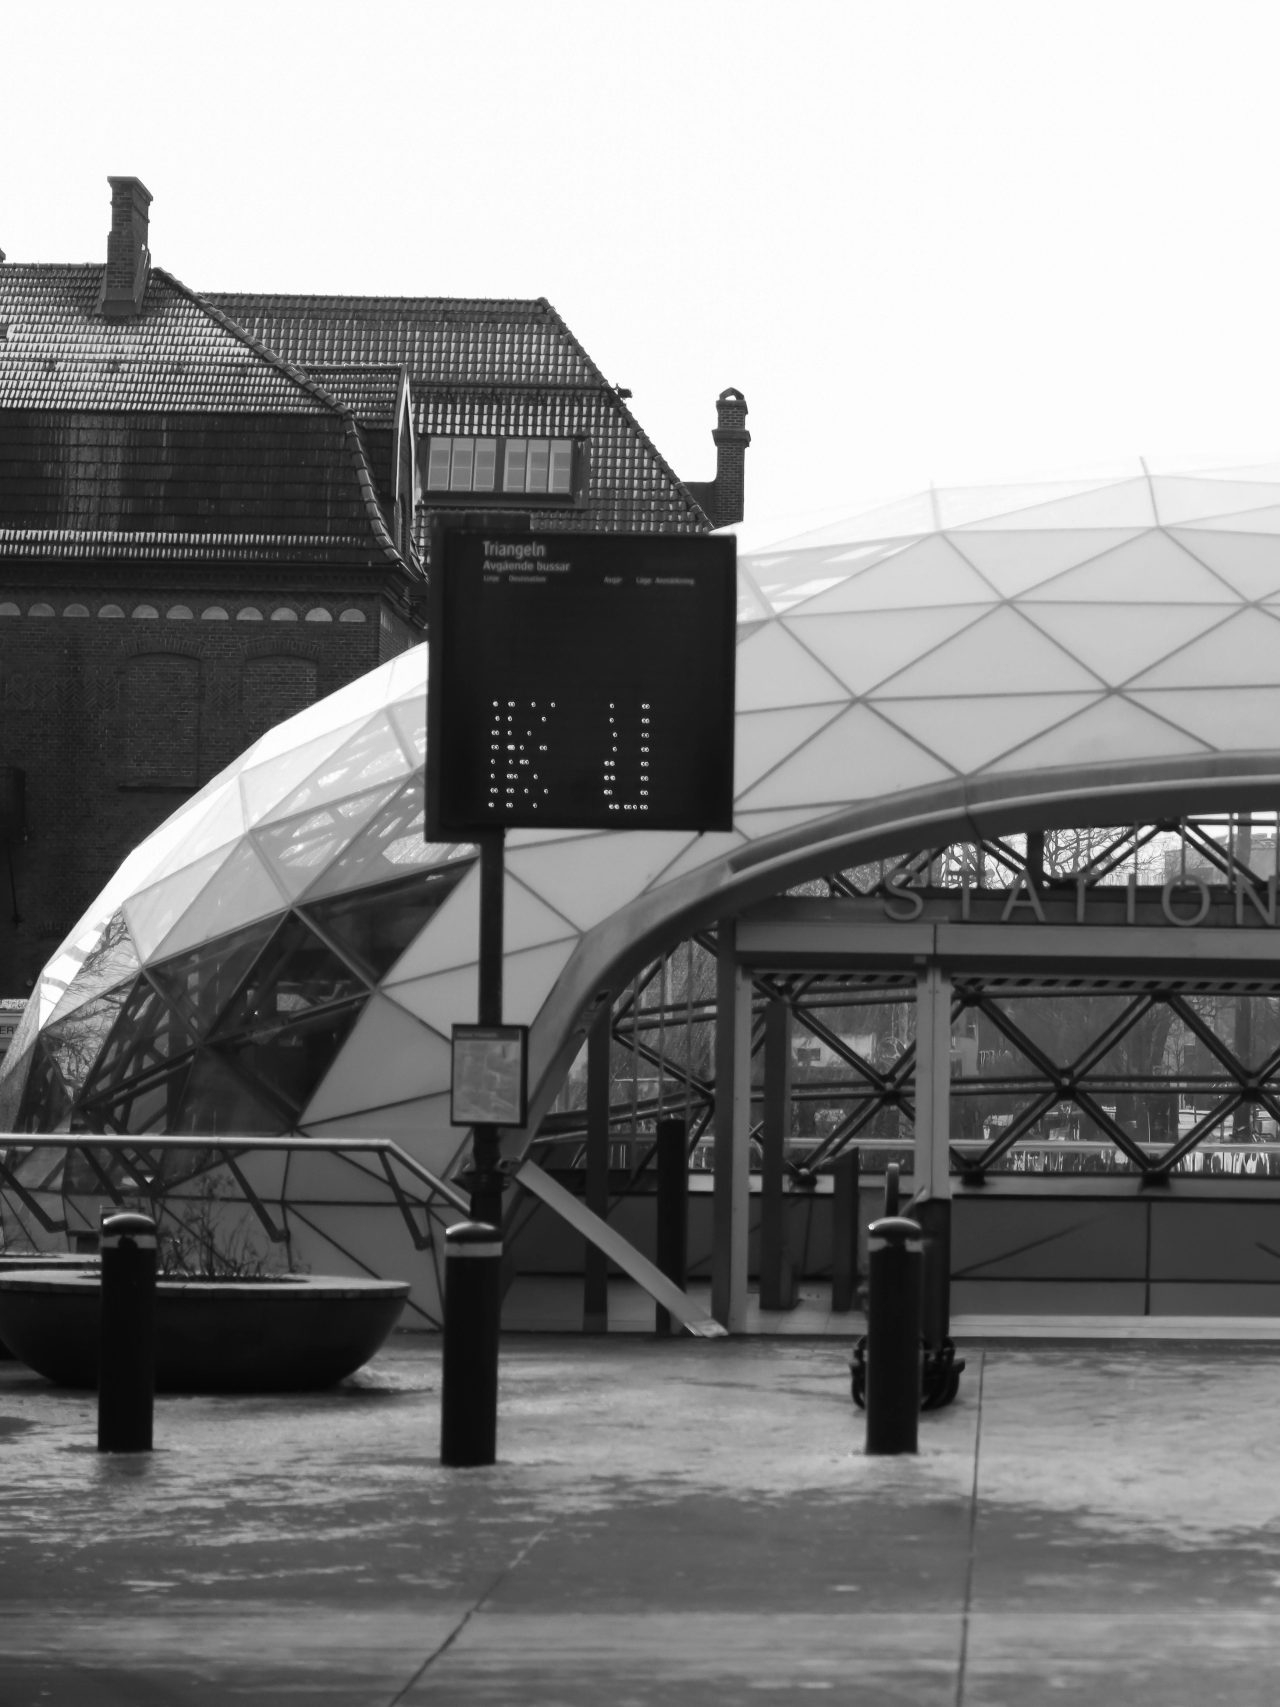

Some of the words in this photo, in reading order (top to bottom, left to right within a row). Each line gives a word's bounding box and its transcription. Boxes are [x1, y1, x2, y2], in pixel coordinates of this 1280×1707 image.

[483, 541, 545, 559] Triangeln
[483, 561, 534, 572] Avgående
[537, 561, 570, 572] bussar
[883, 869, 1276, 926] STATION
